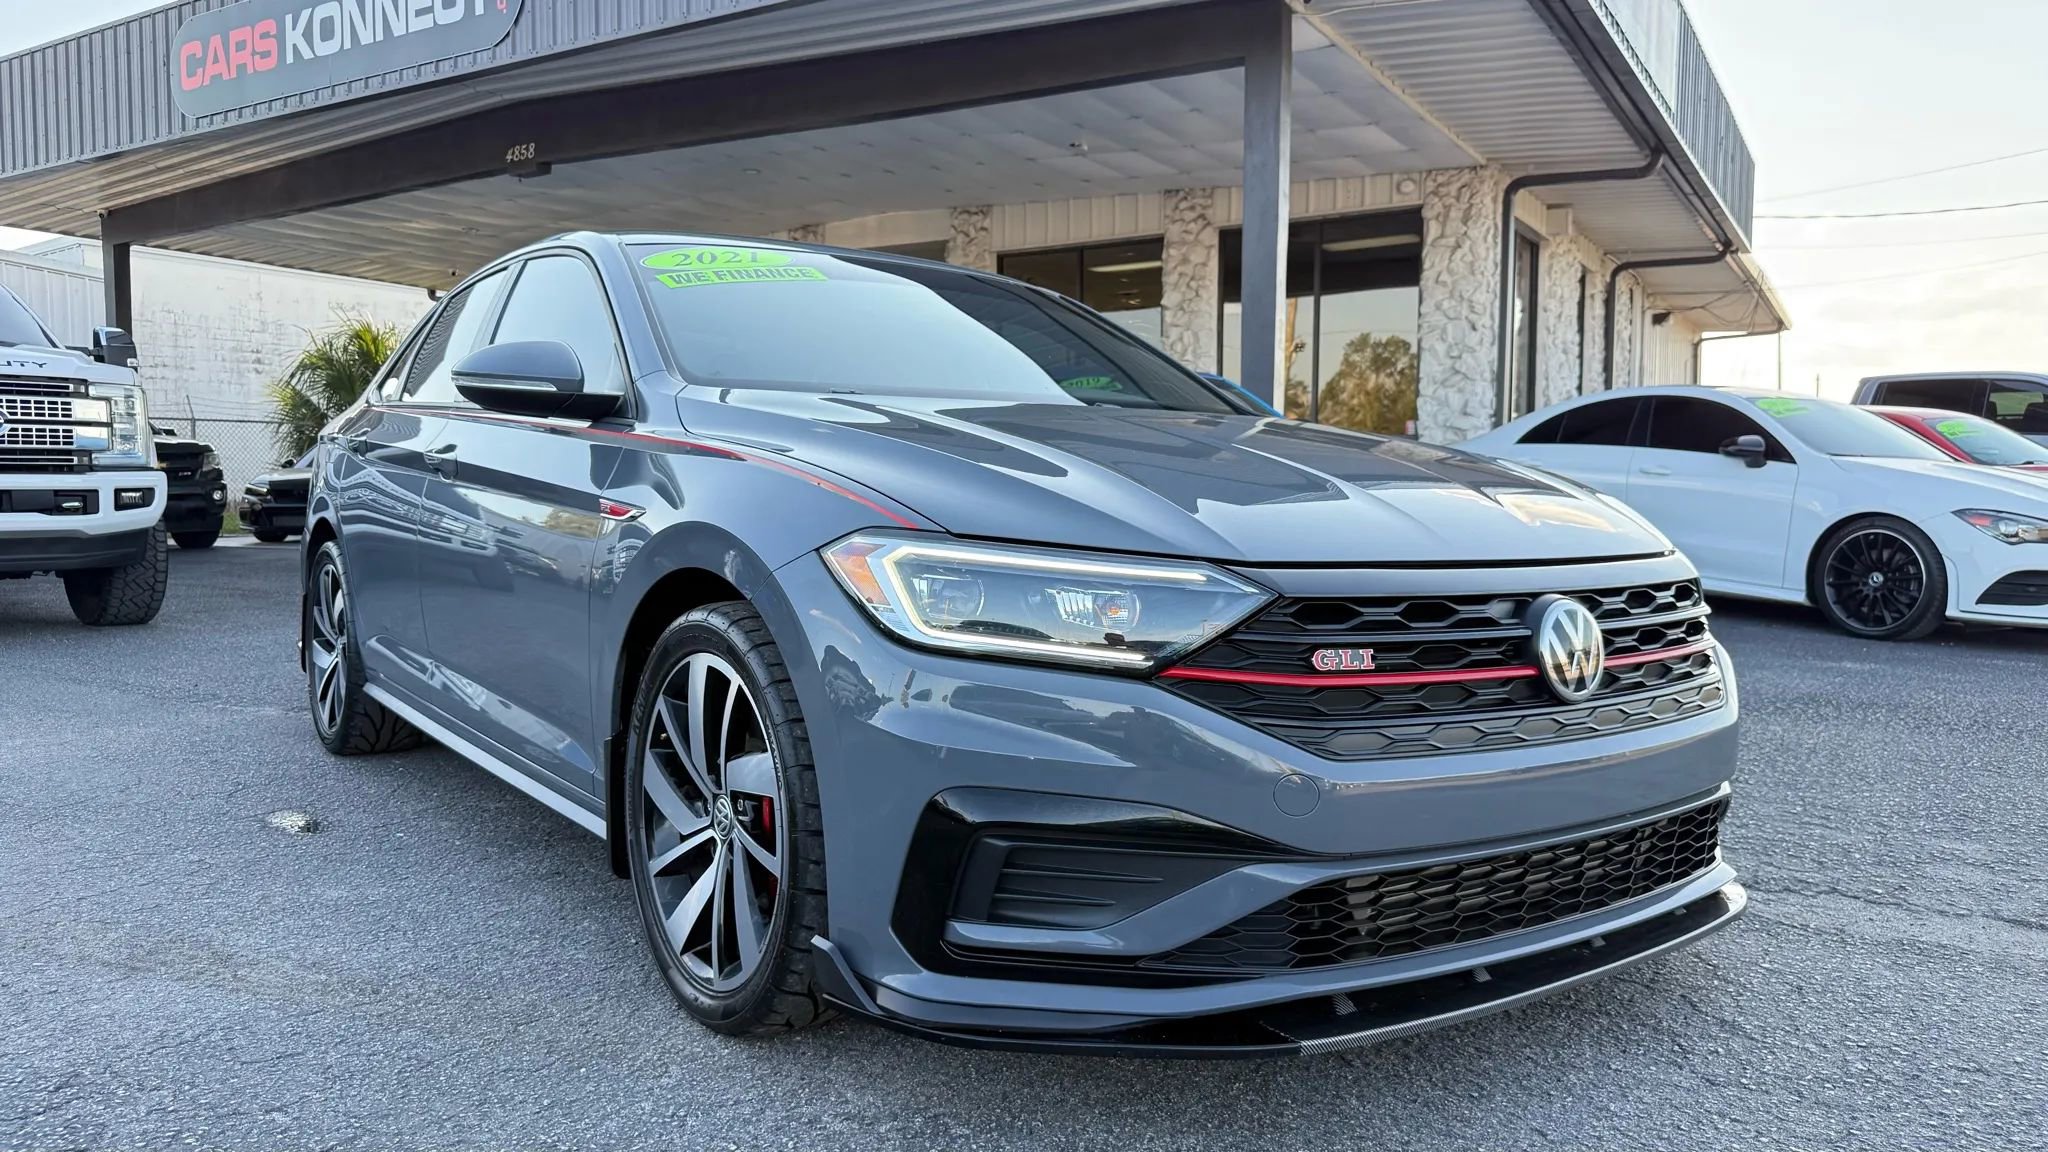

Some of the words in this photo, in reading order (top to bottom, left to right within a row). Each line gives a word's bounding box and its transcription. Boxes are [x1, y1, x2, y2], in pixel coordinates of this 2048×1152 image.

[180, 18, 278, 91] CARS
[505, 142, 536, 163] 4858
[671, 251, 759, 267] 2021
[667, 270, 711, 285] WE
[711, 266, 814, 282] FINANCE
[1311, 649, 1375, 671] GLI
